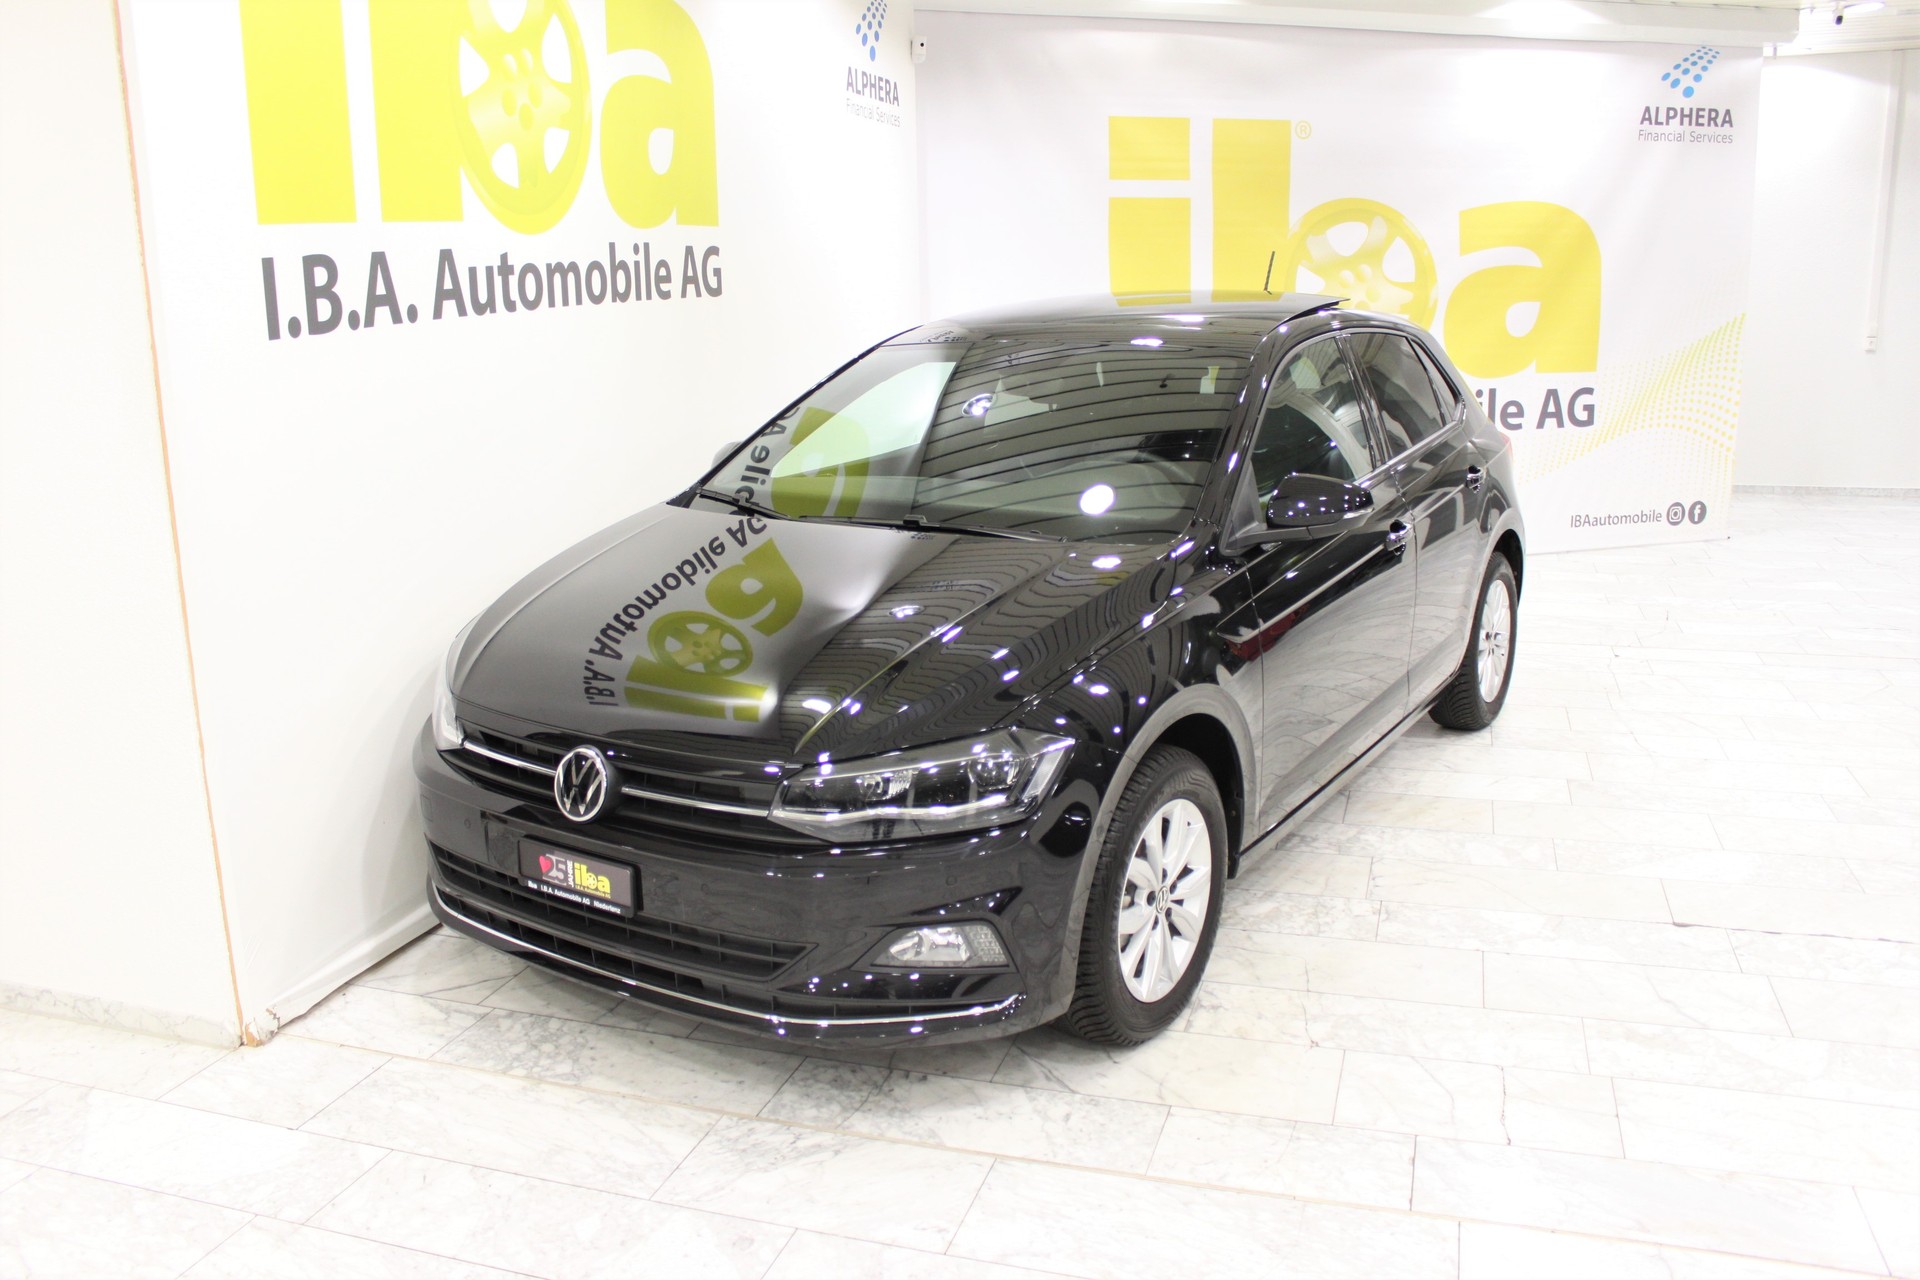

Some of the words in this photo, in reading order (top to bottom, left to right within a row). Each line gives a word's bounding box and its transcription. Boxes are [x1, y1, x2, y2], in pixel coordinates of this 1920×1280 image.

[846, 65, 900, 107] ALPHERA
[1639, 105, 1734, 128] ALPHERA
[1638, 129, 1686, 143] Financial
[1689, 131, 1734, 144] Services
[261, 250, 418, 341] I.B.A.
[432, 242, 672, 321] Automobile
[680, 245, 723, 299] AG
[1535, 386, 1596, 430] AG
[1570, 509, 1663, 528] IBAautomobile
[573, 862, 611, 894] iba
[554, 888, 582, 903] Automobile
